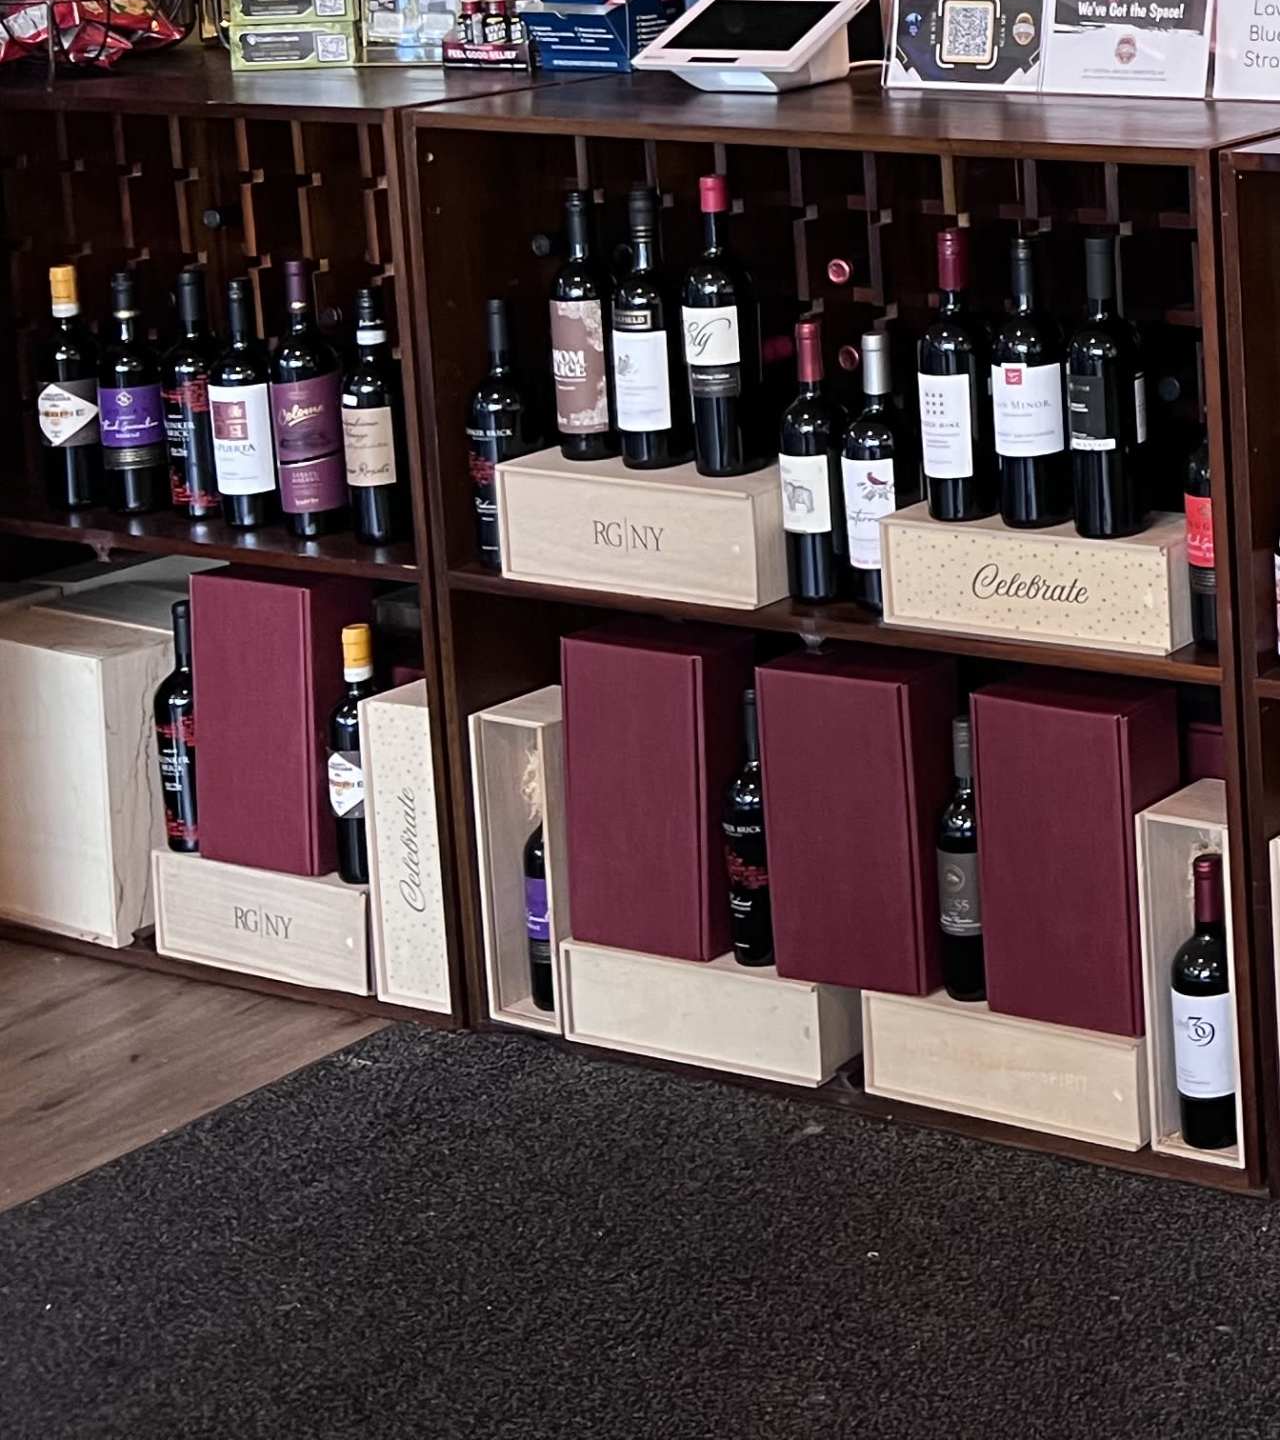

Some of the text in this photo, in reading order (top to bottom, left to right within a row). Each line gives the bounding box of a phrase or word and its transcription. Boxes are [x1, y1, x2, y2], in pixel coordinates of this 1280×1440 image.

[1108, 3, 1128, 17] Got
[1129, 2, 1148, 18] the
[1149, 3, 1185, 22] Space!
[972, 562, 1089, 604] Celebrate
[399, 786, 416, 914] Celebrate
